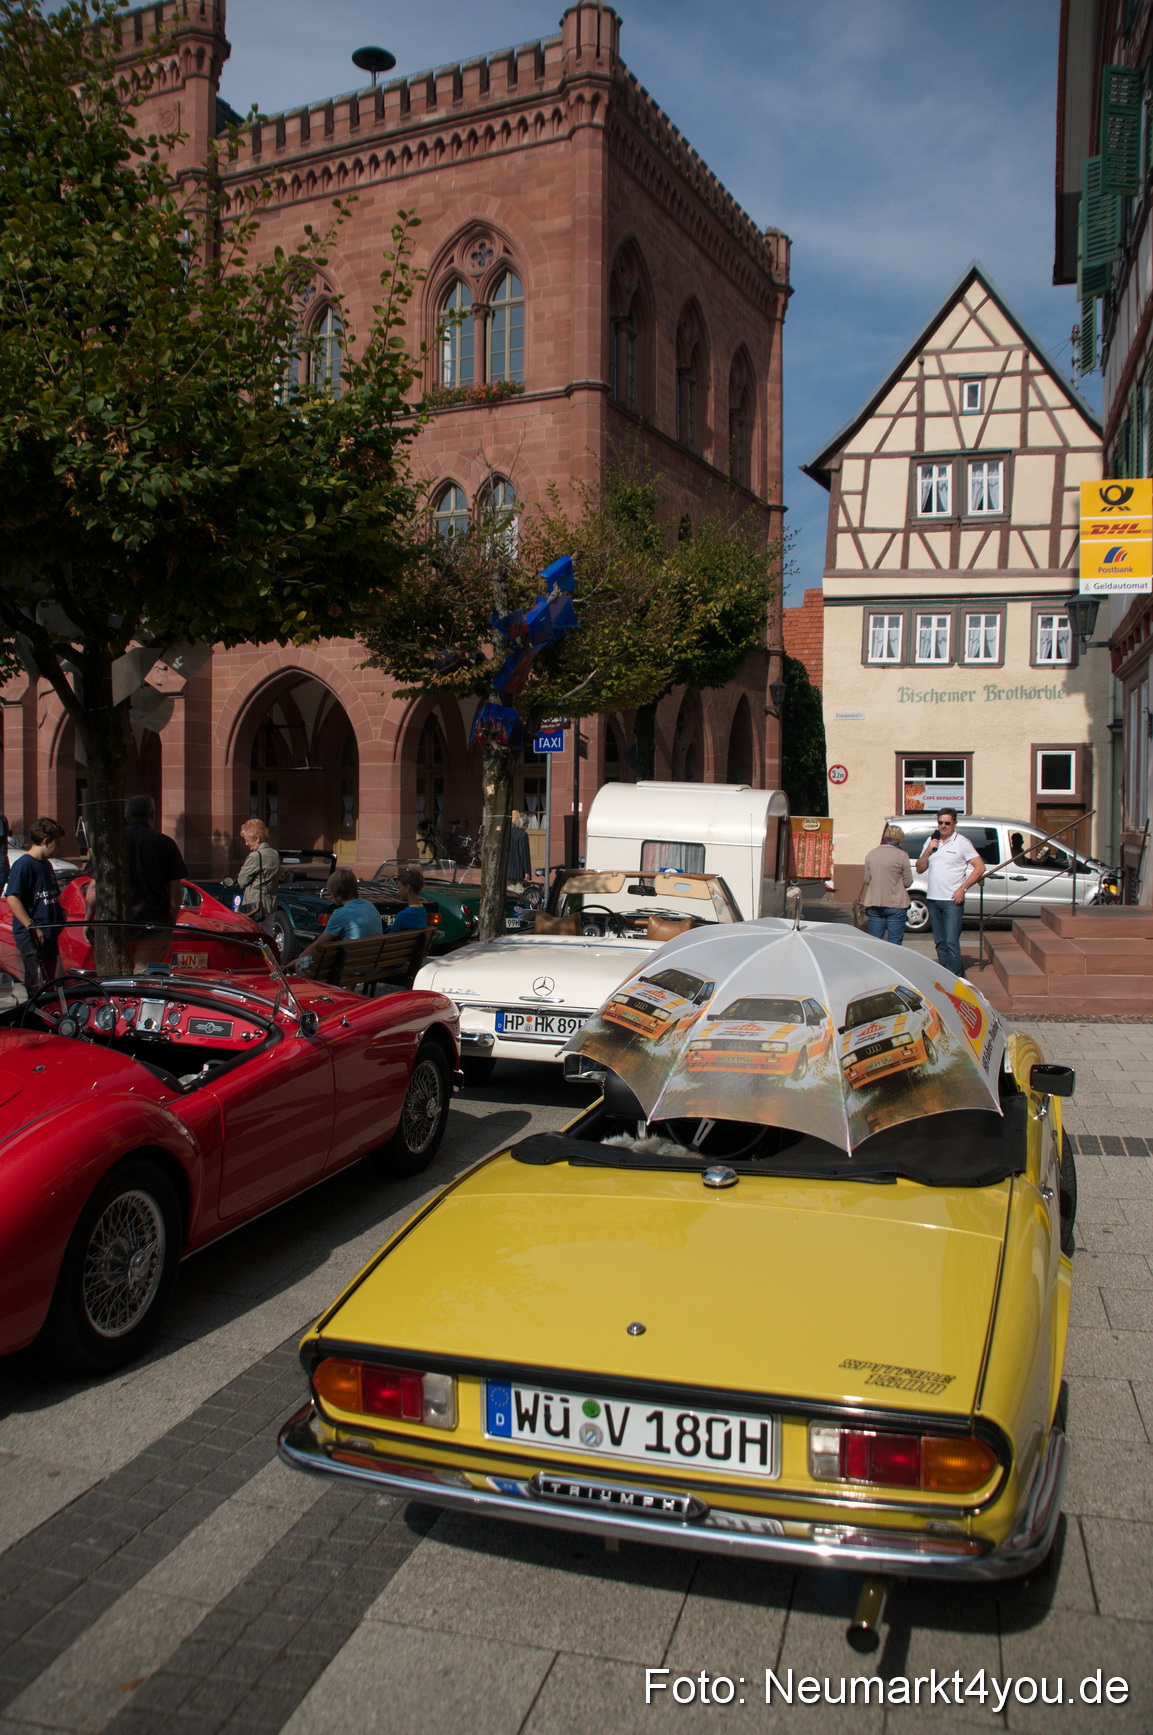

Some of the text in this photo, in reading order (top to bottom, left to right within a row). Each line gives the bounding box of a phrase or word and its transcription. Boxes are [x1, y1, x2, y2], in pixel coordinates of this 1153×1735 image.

[1090, 523, 1142, 535] DHL
[1098, 565, 1133, 573] Postbank
[1093, 582, 1149, 590] Geldautomat
[898, 684, 1067, 705] Bischemer Brotkörble
[539, 737, 561, 748] TAXI
[504, 1014, 525, 1031] HP
[534, 1017, 555, 1034] HK
[495, 1413, 505, 1427] D
[604, 1402, 631, 1447] V
[644, 1409, 769, 1466] 180H
[550, 1482, 676, 1511] TRIUMPH
